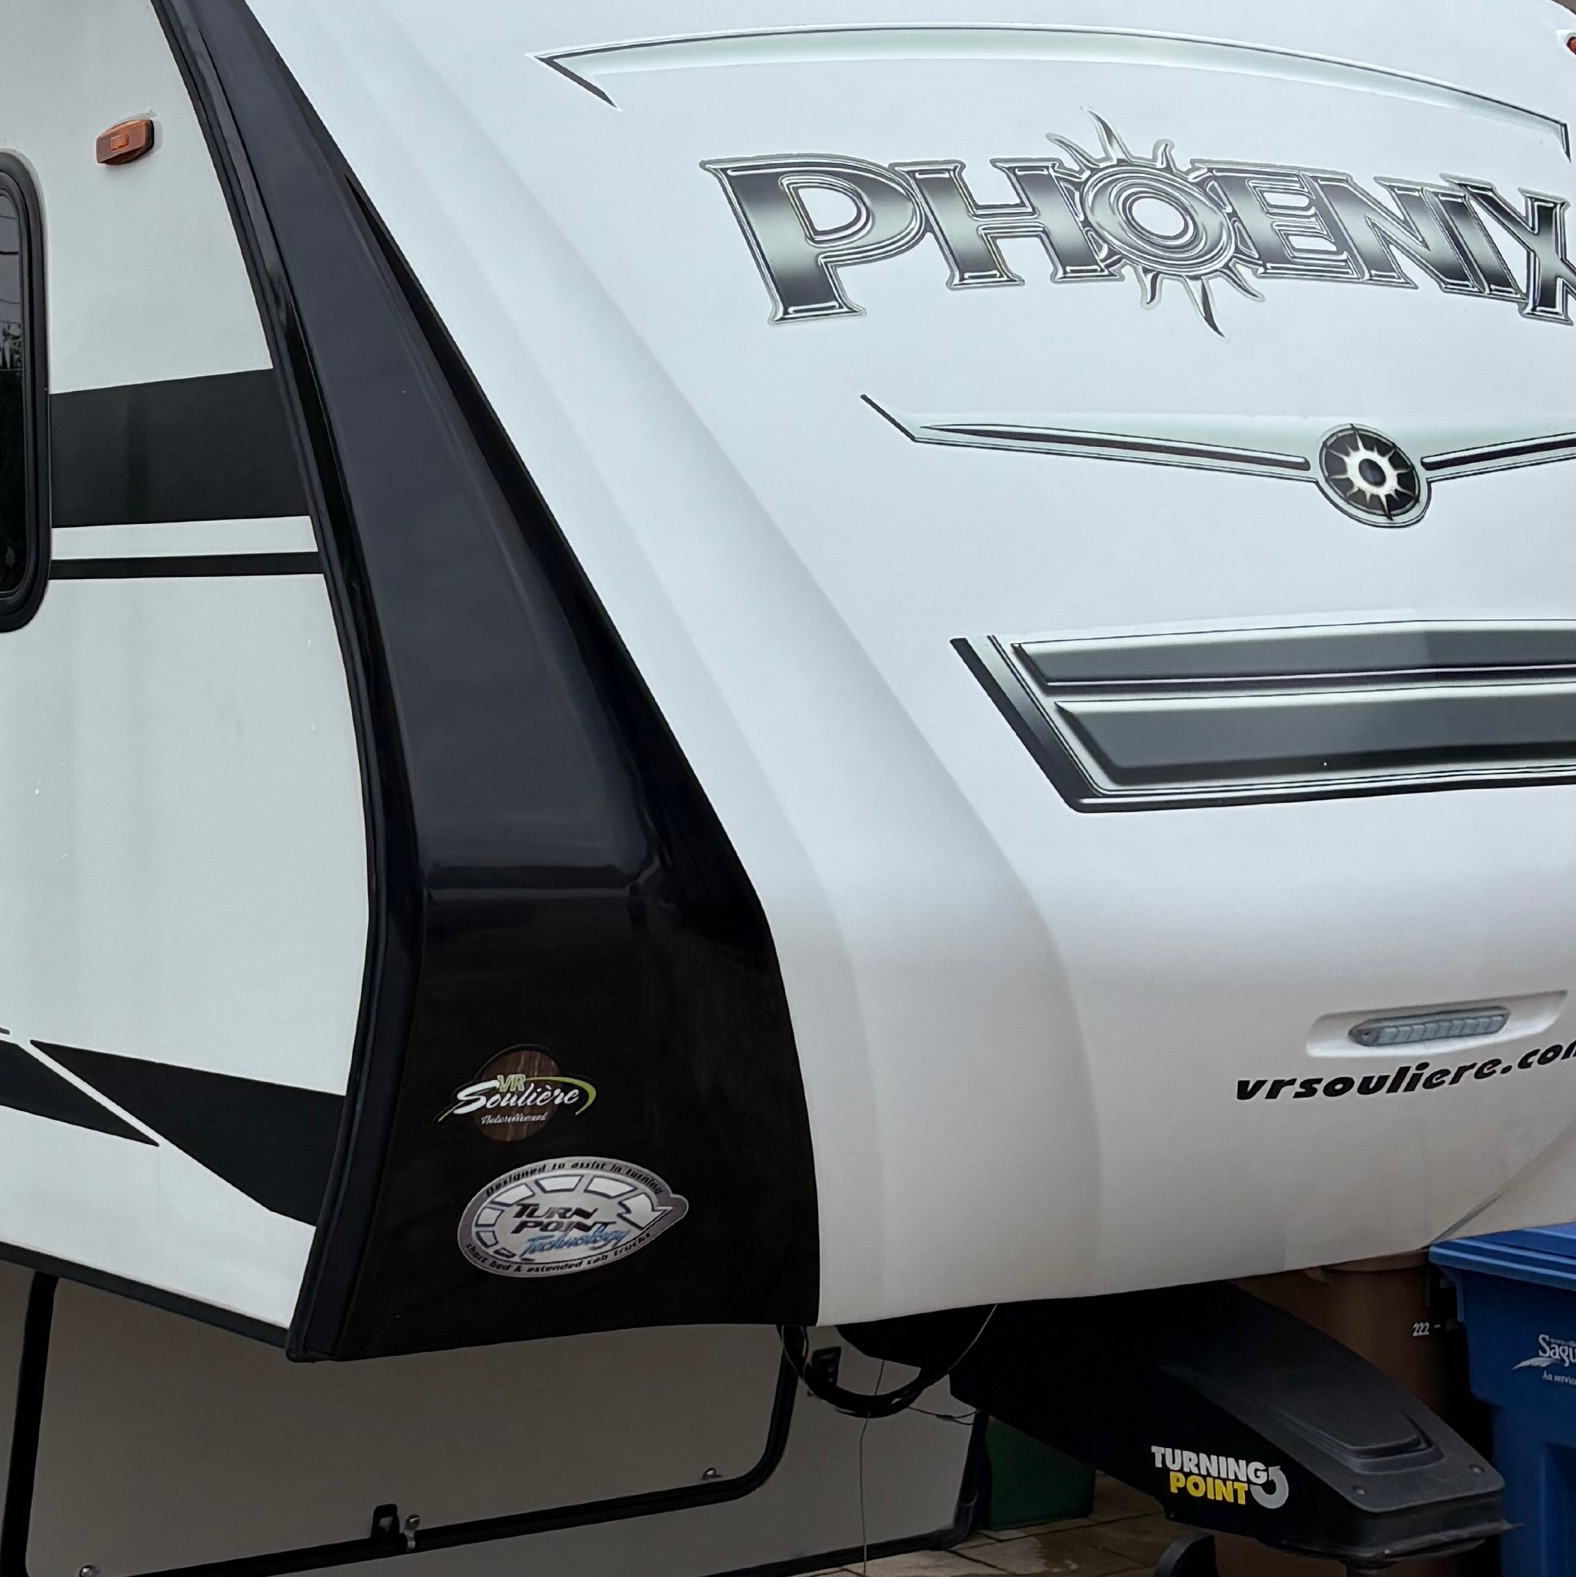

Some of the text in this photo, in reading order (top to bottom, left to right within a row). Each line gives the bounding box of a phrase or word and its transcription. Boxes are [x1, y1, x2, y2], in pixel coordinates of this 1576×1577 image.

[700, 152, 1576, 326] PHOENIX
[453, 1079, 580, 1114] Soulière
[497, 1074, 526, 1092] VR
[485, 1160, 664, 1197] Designed to assist in turning
[511, 1220, 617, 1235] POINT
[513, 1202, 599, 1220] TURN
[489, 1258, 512, 1272] bed
[513, 1263, 523, 1273] &
[525, 1260, 584, 1273] extended
[586, 1253, 609, 1266] cab
[613, 1232, 652, 1257] trucks
[520, 1224, 631, 1262] Technology
[1151, 1445, 1268, 1485] TURNING
[1169, 1471, 1248, 1505] POINT
